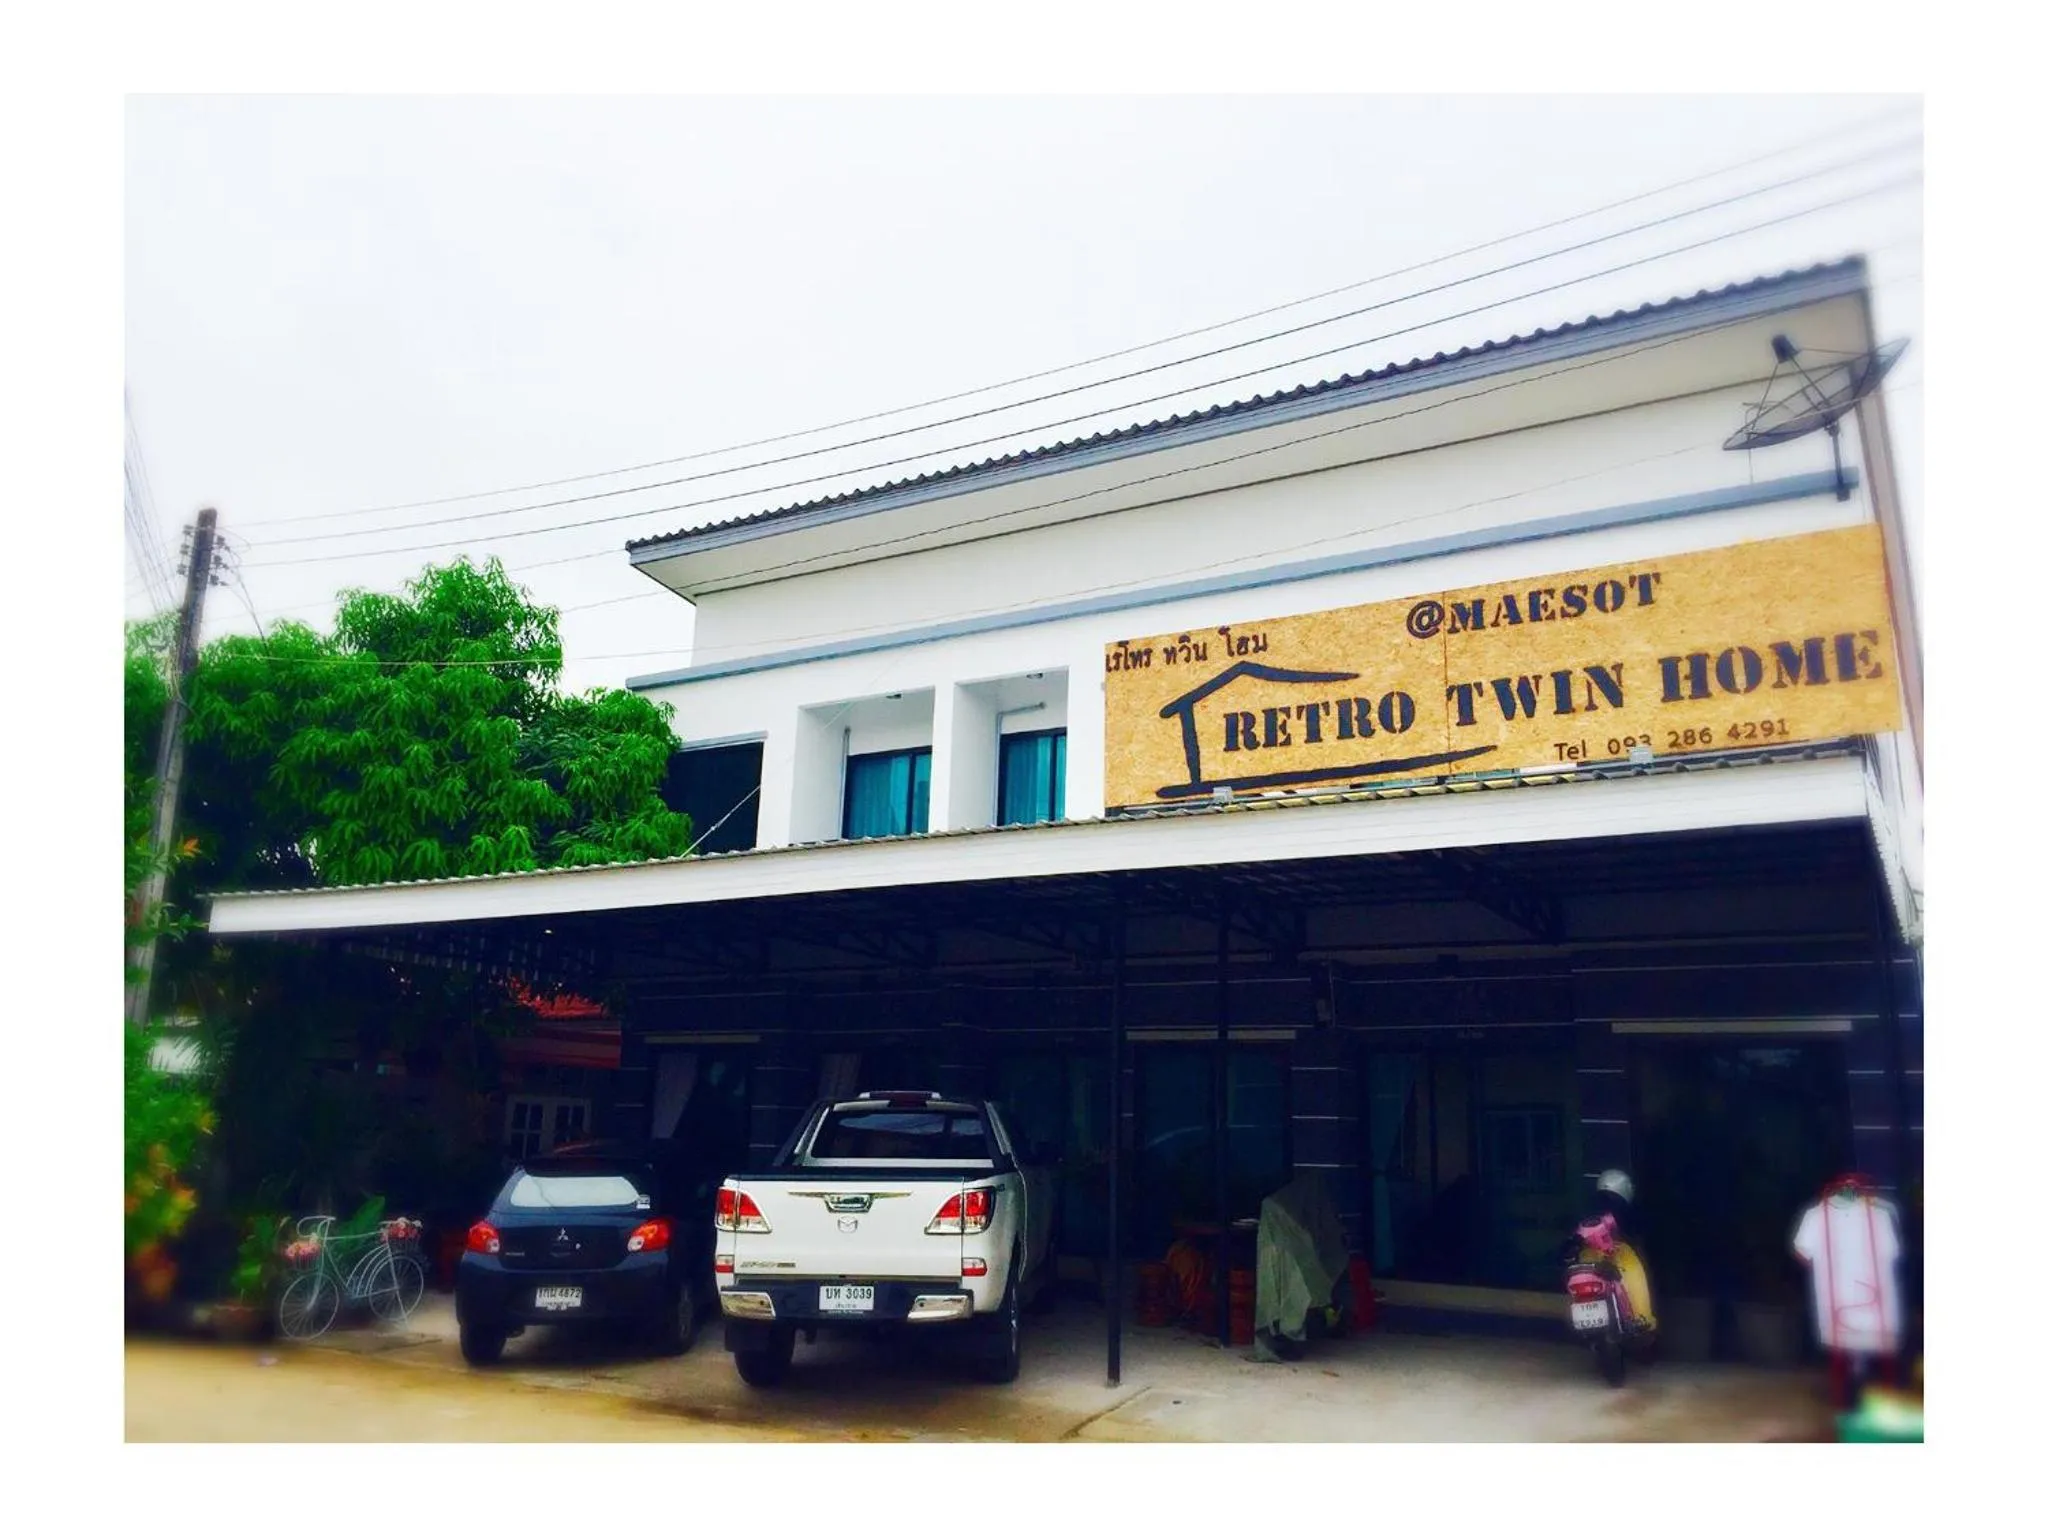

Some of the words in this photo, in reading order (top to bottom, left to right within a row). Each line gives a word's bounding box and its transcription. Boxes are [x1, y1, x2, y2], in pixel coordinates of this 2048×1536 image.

[1406, 572, 1661, 639] @MAESOT
[1218, 625, 1268, 658] โฮม
[1223, 691, 1416, 752] RETRO
[1446, 662, 1625, 727] TWIN
[1657, 630, 1883, 704] HOME
[1553, 739, 1587, 761] Tel
[1667, 727, 1713, 749] 286
[1727, 717, 1790, 740] 4291
[846, 1287, 872, 1299] 3039
